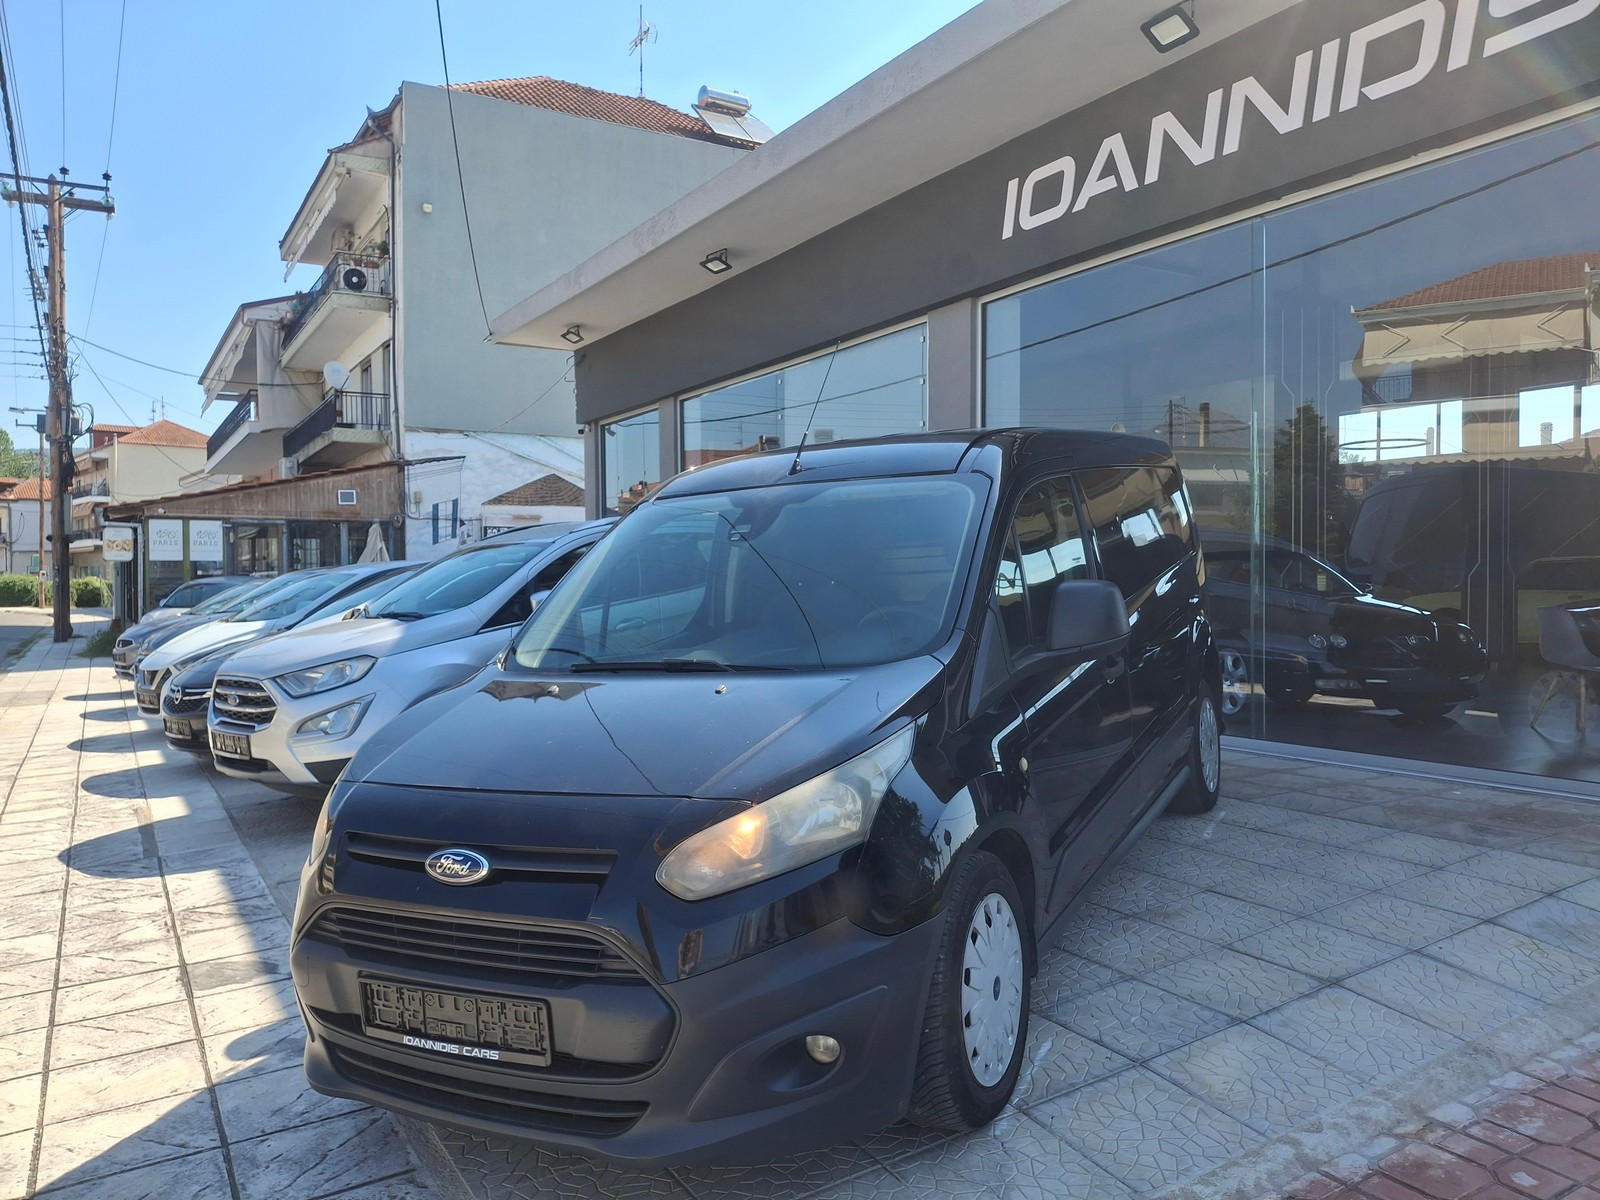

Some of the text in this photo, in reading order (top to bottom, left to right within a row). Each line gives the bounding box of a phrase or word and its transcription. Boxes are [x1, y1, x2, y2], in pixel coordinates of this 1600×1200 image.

[436, 854, 472, 875] Ford
[403, 1035, 500, 1060] IOANNIDIS CARS
